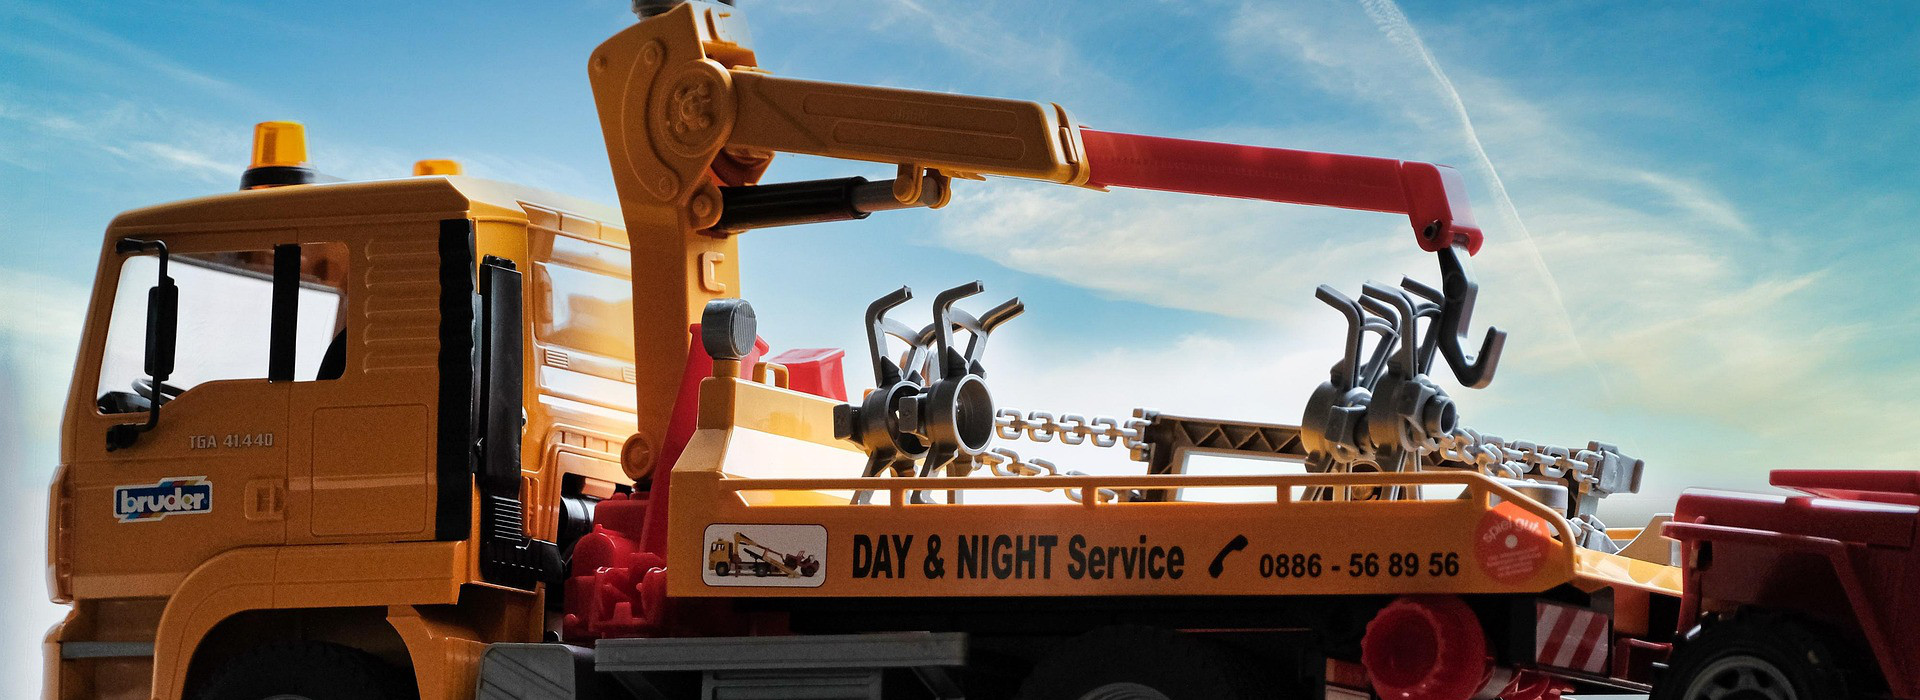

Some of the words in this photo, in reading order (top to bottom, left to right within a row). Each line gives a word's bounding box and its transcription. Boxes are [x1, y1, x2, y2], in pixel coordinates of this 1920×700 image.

[188, 435, 218, 449] TGA
[223, 433, 274, 448] 41.440
[120, 487, 206, 513] bruder
[1482, 514, 1513, 543] spiel
[1515, 517, 1543, 535] gut
[852, 534, 914, 579] DAY
[923, 533, 945, 580] &
[957, 533, 1058, 580] NIGHT
[1067, 533, 1185, 580] Service
[1259, 553, 1322, 578] 0886
[1349, 552, 1380, 577] 56
[1388, 552, 1419, 577] 89
[1428, 552, 1460, 577] 56
